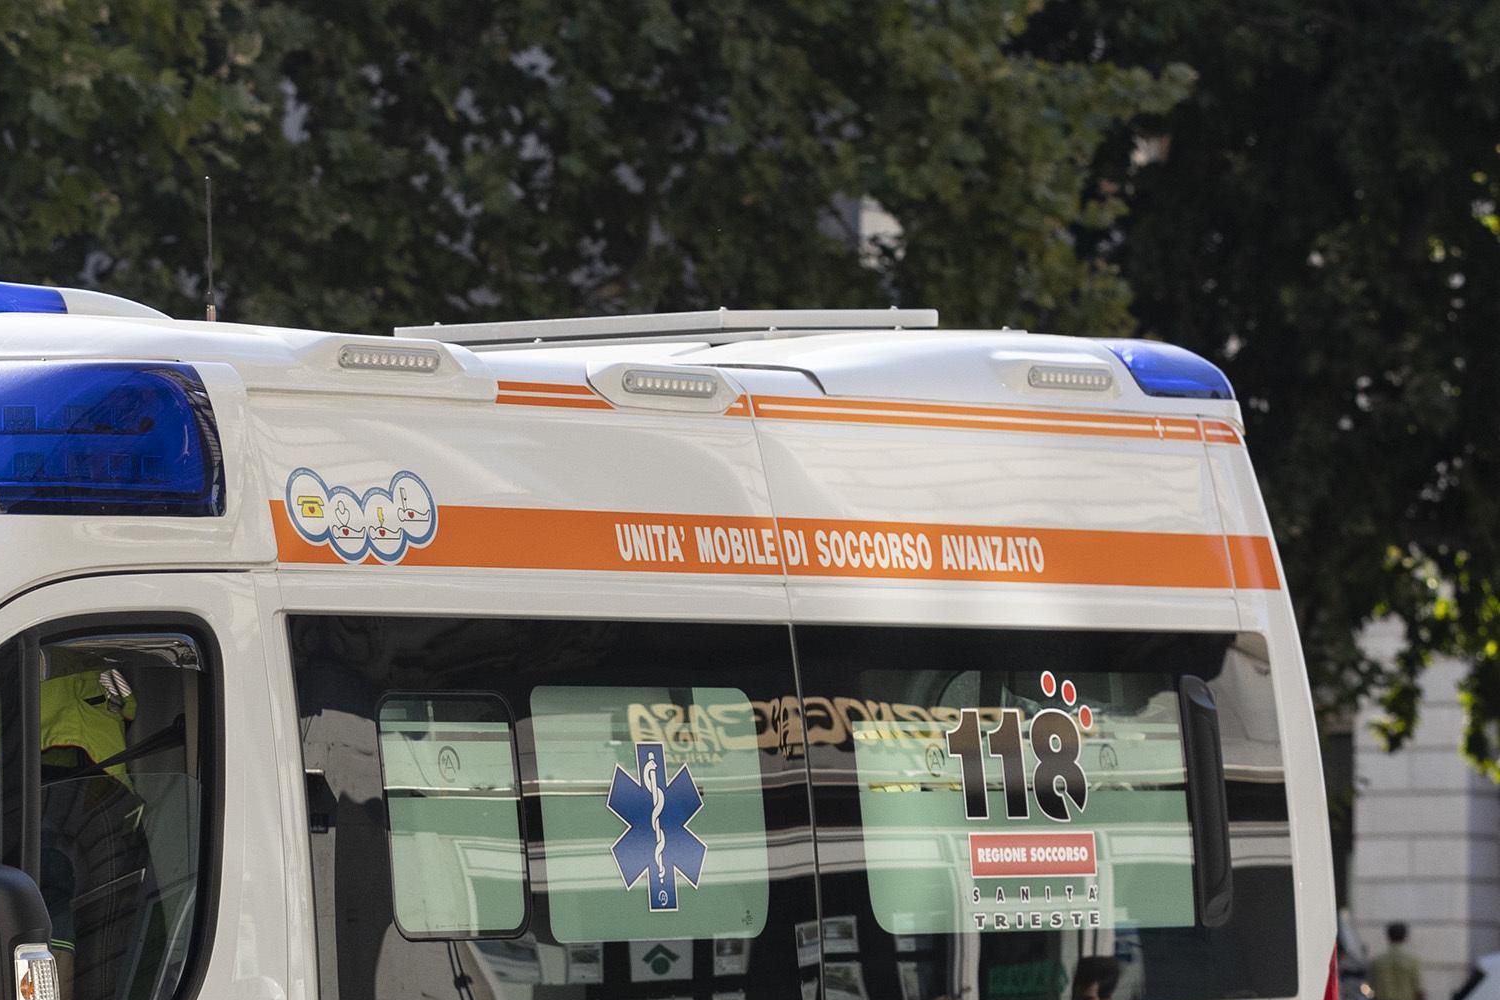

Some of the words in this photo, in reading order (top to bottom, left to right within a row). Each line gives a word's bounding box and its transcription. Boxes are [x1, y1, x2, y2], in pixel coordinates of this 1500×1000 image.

[694, 526, 779, 565] MOBILE
[783, 529, 809, 566] DI
[814, 529, 933, 570] SOCCORSO
[941, 534, 1045, 573] AVANZATO
[946, 708, 1088, 822] 118
[977, 847, 1027, 863] REGIONE
[1030, 846, 1089, 863] SOCCORSO
[974, 911, 1101, 929] TRIESTE
